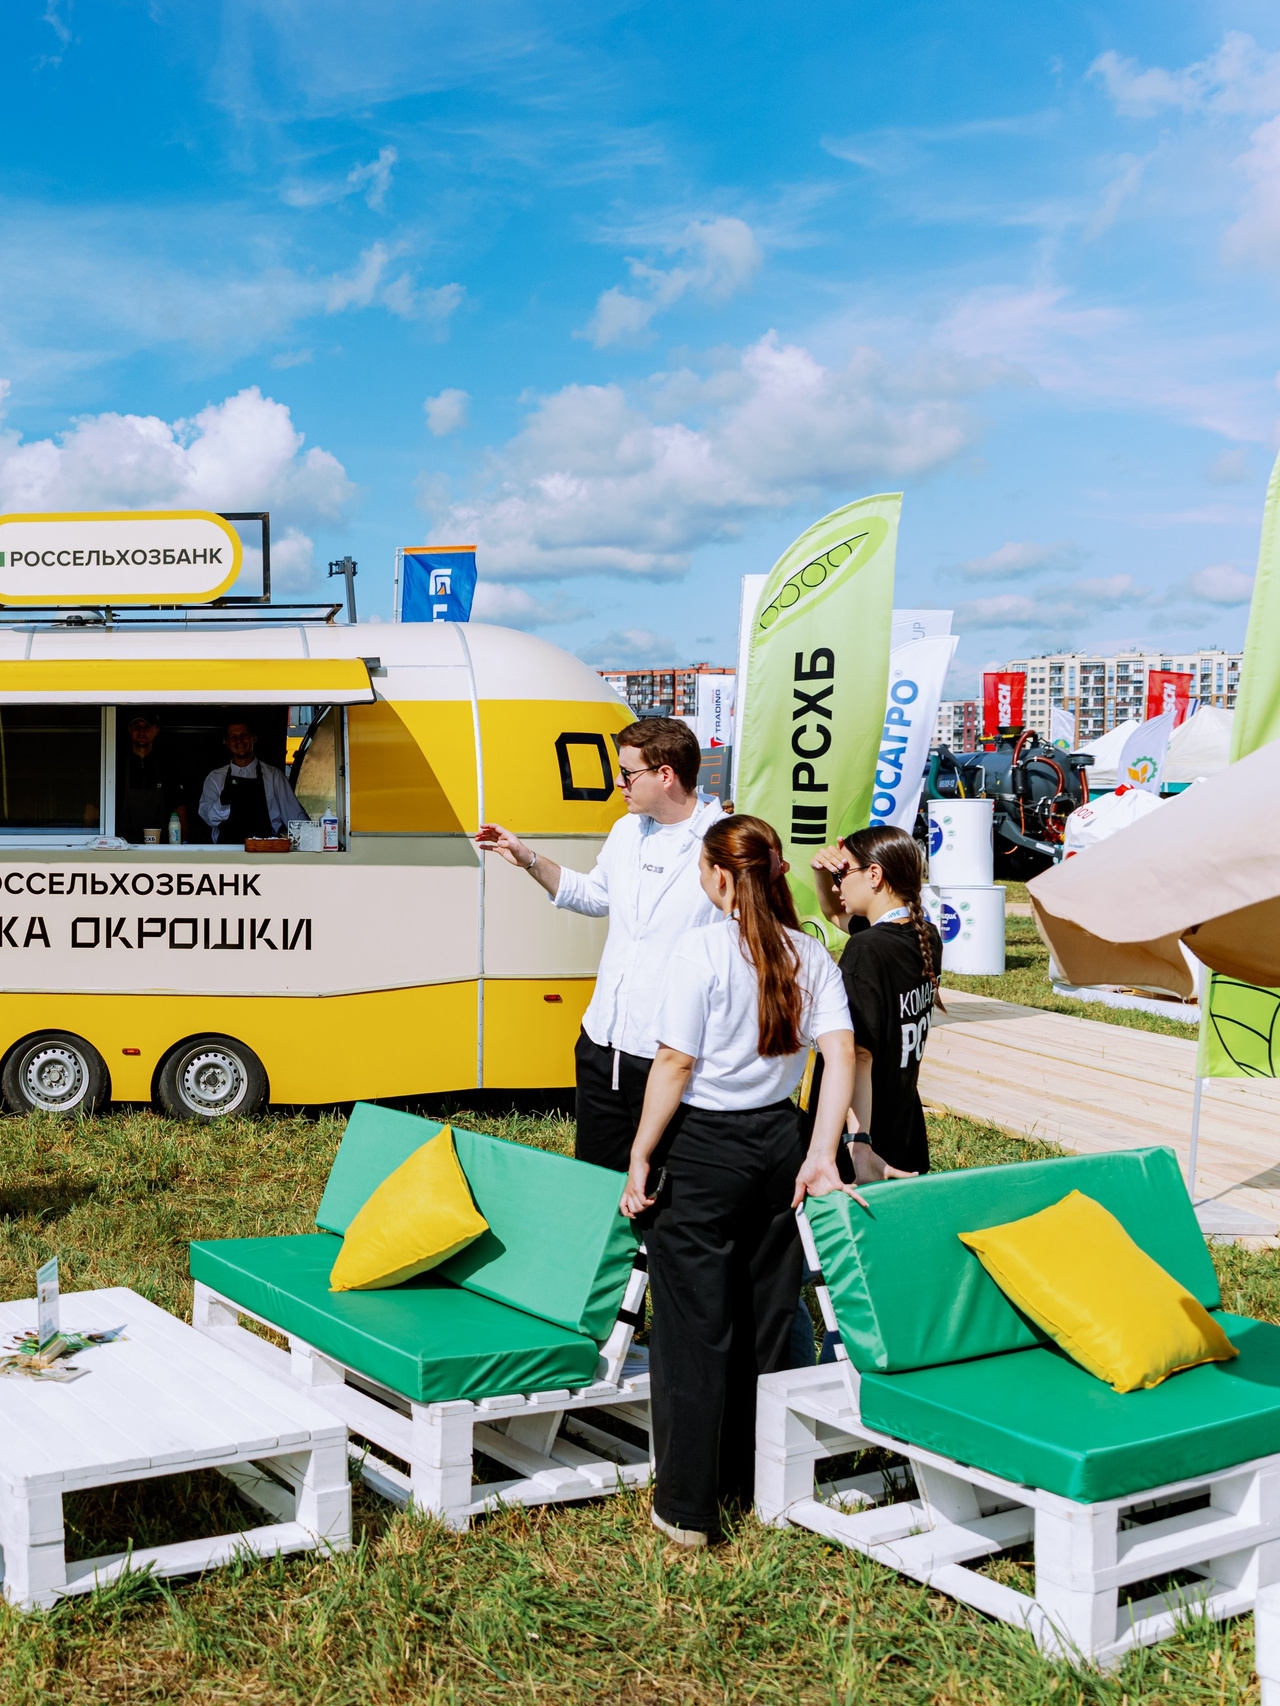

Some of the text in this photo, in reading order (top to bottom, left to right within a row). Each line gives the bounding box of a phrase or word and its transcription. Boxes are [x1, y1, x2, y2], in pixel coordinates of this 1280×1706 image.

[10, 548, 223, 568] РОССЕЛЬХОЗБАНК
[791, 647, 836, 792] РСХБ
[71, 916, 312, 951] ОКРОШКИ
[900, 975, 941, 1018] КОМАН
